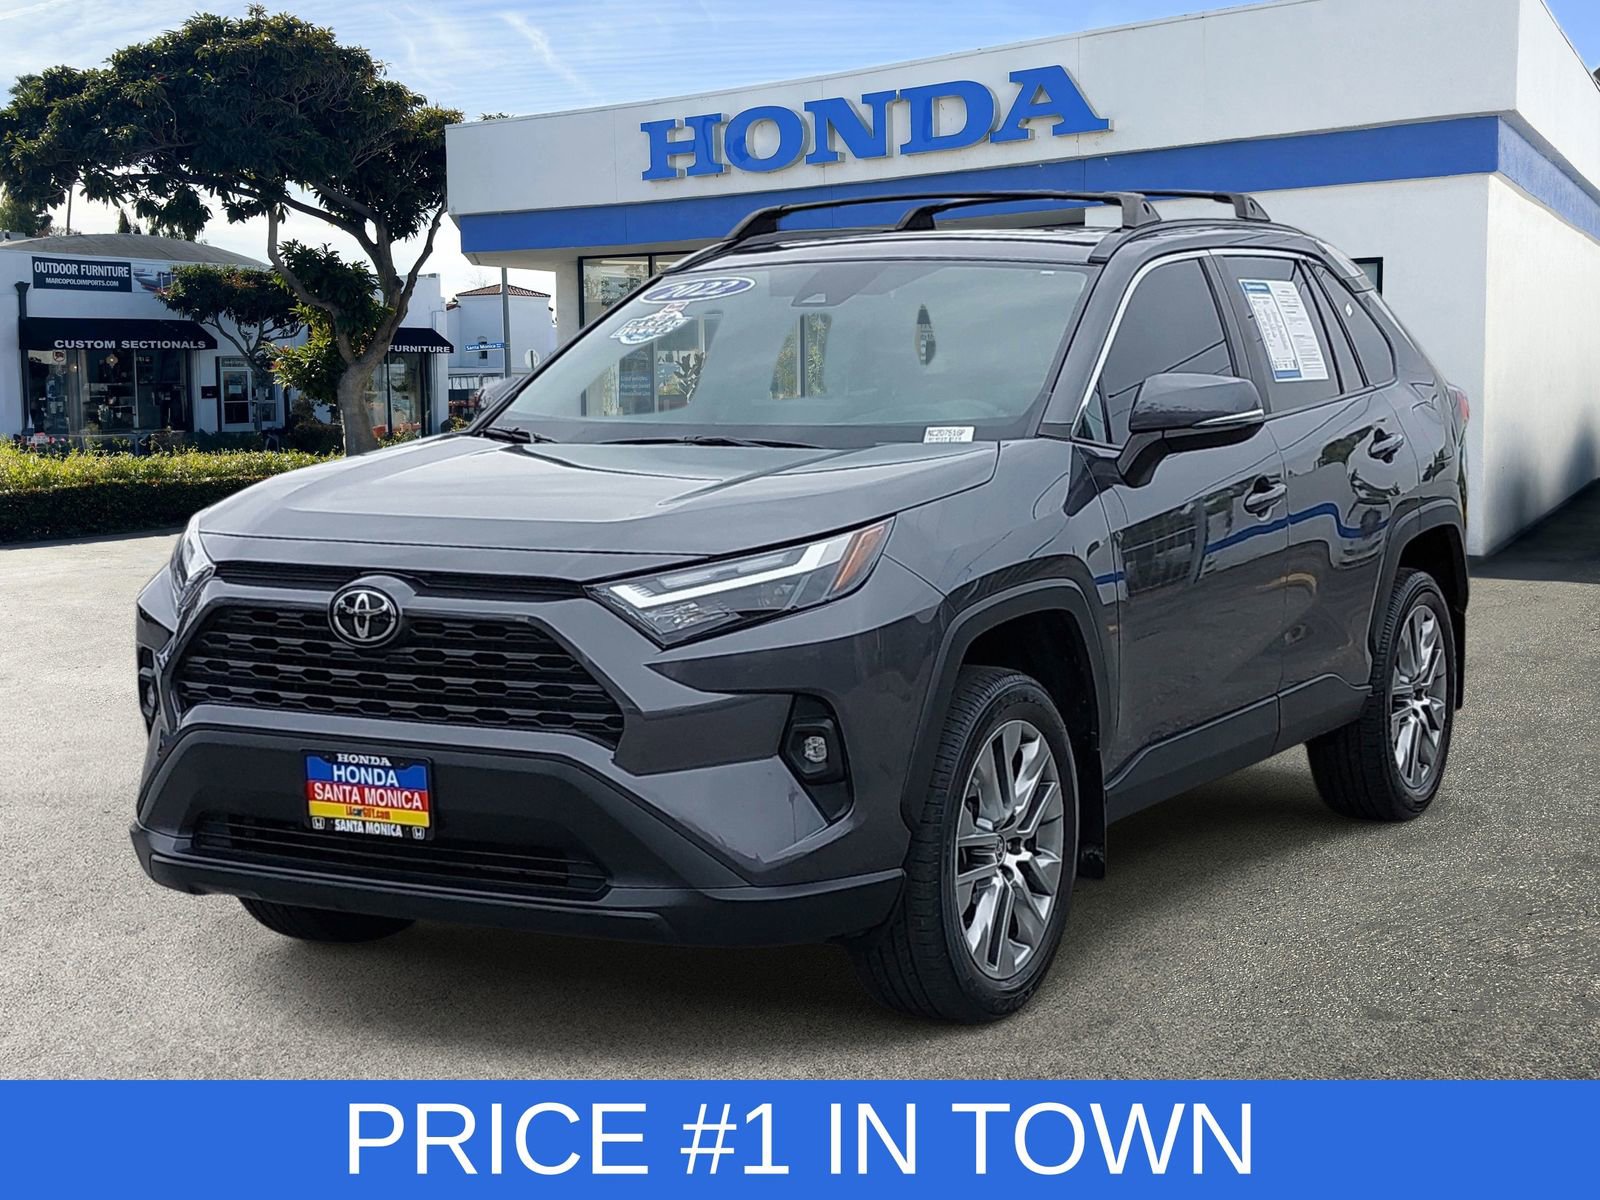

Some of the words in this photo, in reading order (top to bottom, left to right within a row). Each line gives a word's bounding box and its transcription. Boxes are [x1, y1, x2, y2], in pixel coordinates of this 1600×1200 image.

[641, 65, 1112, 181] HONDA
[34, 261, 78, 276] OUTDOOR
[80, 264, 130, 278] FURNITURE
[45, 277, 119, 287] MARCOPOLOIMPORTS.COM
[654, 279, 741, 300] 2022
[54, 339, 116, 349] CUSTOM
[121, 340, 206, 349] SECTIONALS
[388, 344, 450, 353] FURNITURE
[337, 753, 392, 767] HONDA
[333, 764, 399, 787] HONDA
[314, 782, 362, 804] SANTA
[364, 787, 423, 810] MONICA
[334, 819, 364, 834] SANTA
[365, 822, 403, 837] MONICA
